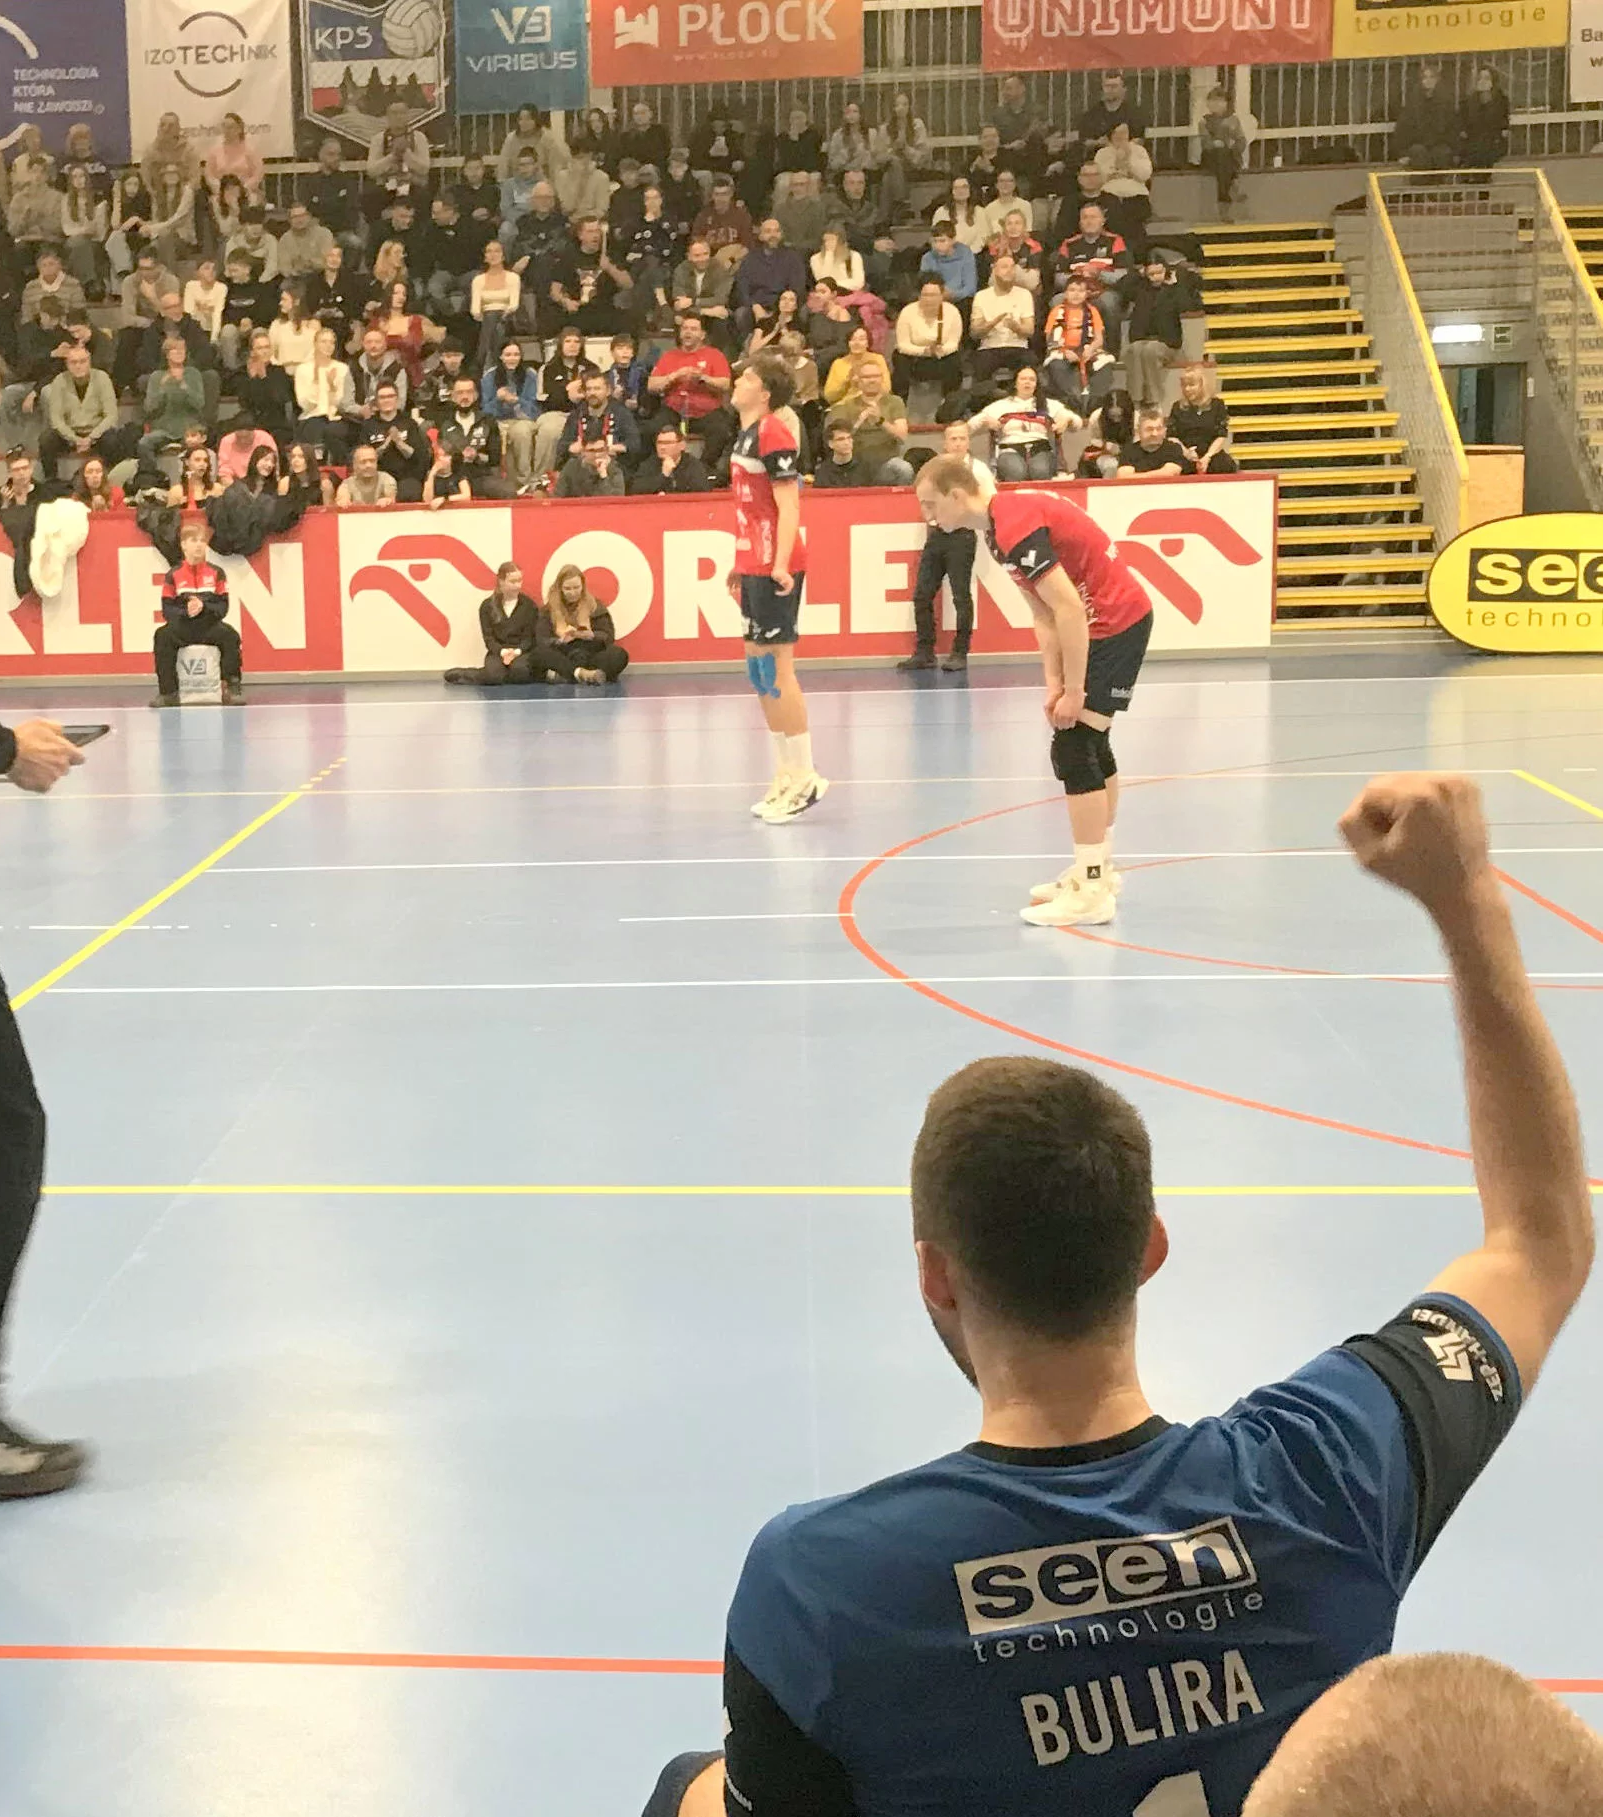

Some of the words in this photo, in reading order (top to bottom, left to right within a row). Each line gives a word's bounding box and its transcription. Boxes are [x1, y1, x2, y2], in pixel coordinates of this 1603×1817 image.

[678, 0, 836, 47] PŁOCK
[1355, 5, 1546, 34] technologie
[314, 26, 373, 50] KPS
[144, 44, 277, 65] IZOTECHNIK
[466, 51, 577, 73] VIRIBUS
[13, 67, 99, 81] TECHNOLOGIA
[12, 82, 55, 98] KTÓRA
[970, 1529, 1249, 1620] seen
[972, 1591, 1264, 1665] technologie
[1020, 1649, 1265, 1767] BULIRA
